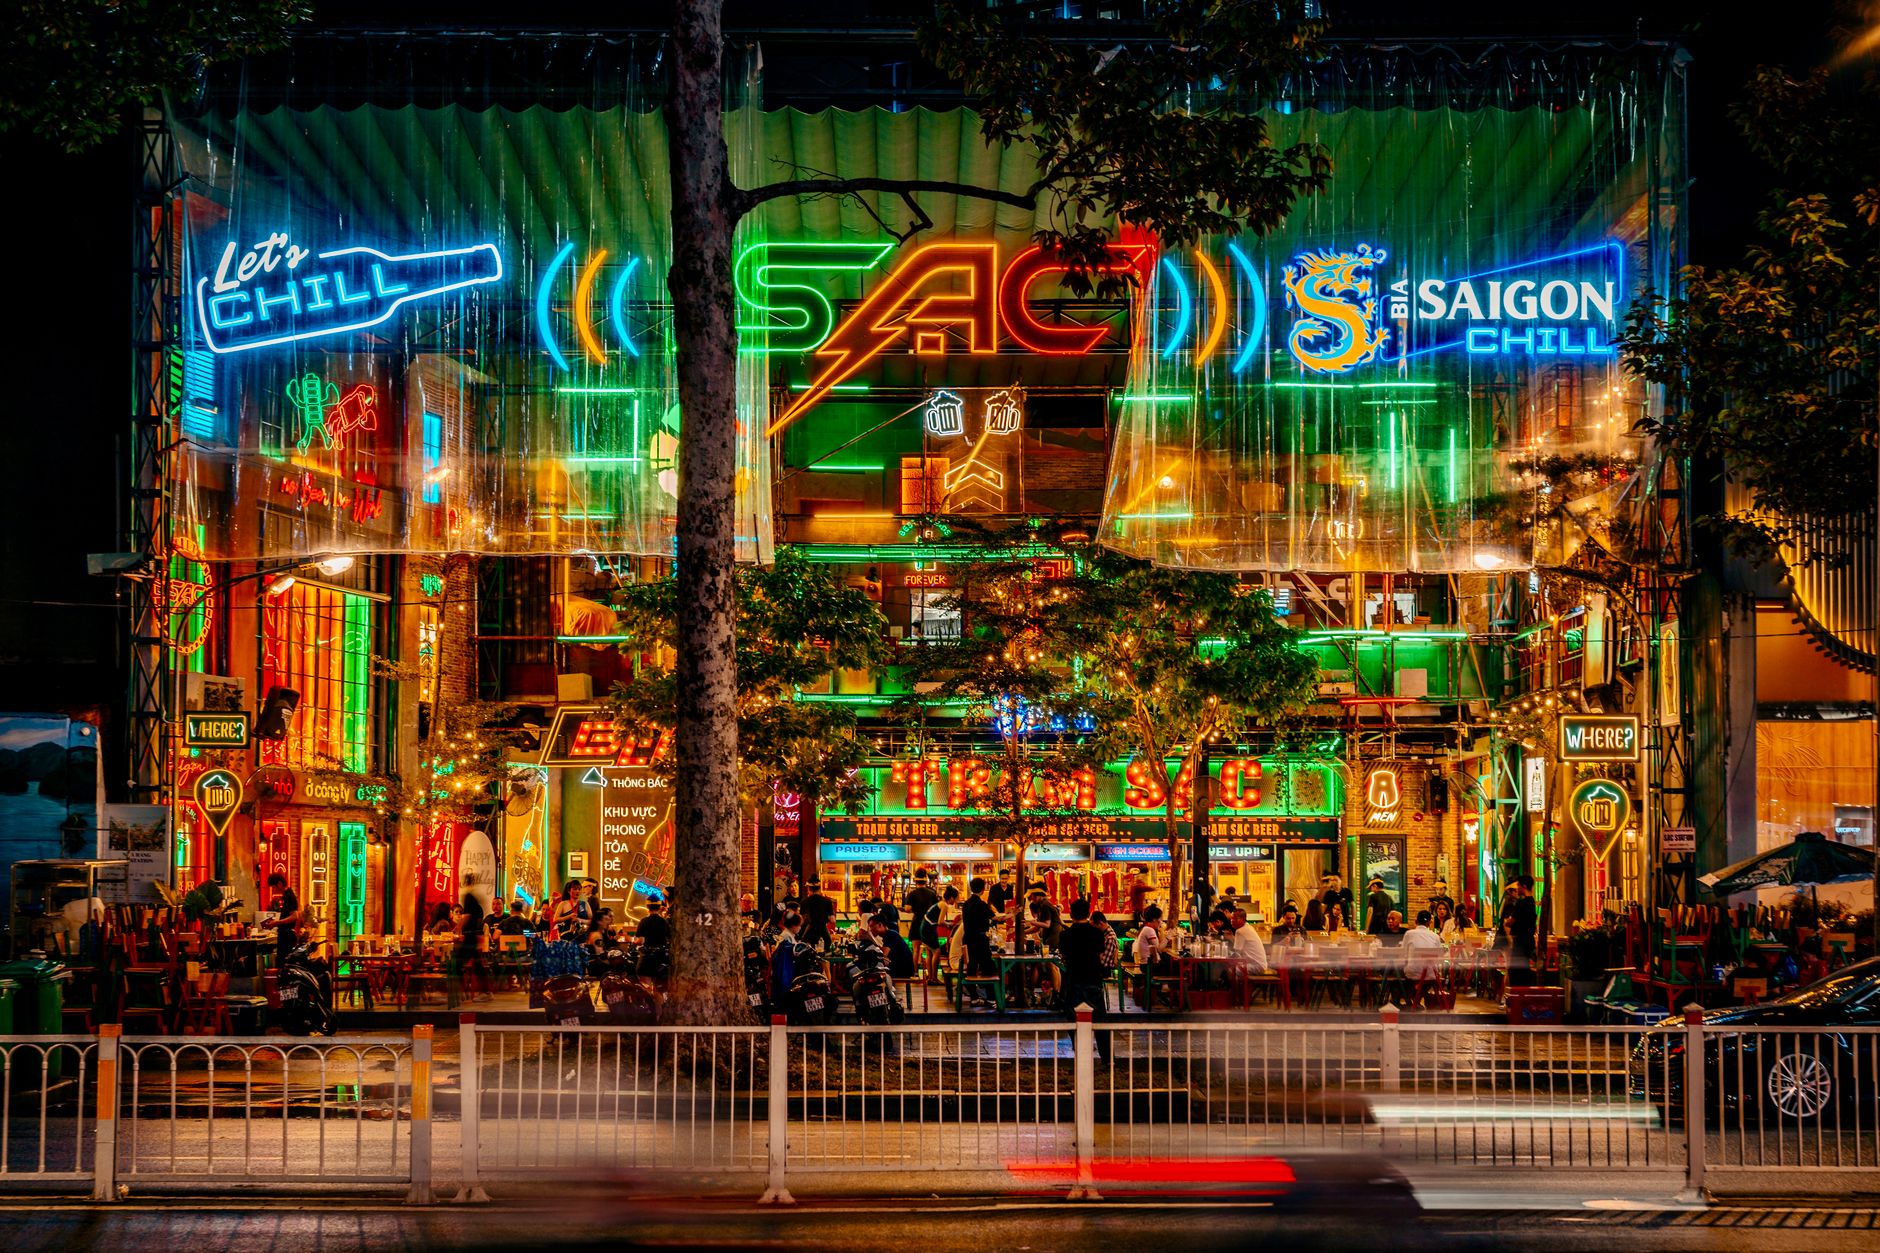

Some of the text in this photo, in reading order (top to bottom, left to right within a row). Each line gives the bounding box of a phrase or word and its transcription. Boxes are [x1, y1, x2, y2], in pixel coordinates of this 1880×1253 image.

[213, 233, 310, 292] Let's
[210, 263, 409, 329] CHILL
[1391, 279, 1409, 319] BIA
[1418, 279, 1615, 321] SAIGON
[1465, 327, 1614, 355] CHILL
[189, 721, 245, 739] WHERE?
[1566, 727, 1634, 749] WHERE?
[611, 776, 646, 788] THÔNG
[604, 806, 657, 820] KHU VỰC
[1370, 811, 1398, 823] MEN
[604, 824, 646, 836] PHONG
[912, 823, 938, 836] BEER
[1252, 823, 1280, 836] BEER
[604, 839, 629, 853] TỎA
[1235, 847, 1260, 857] UP!!
[464, 850, 491, 866] HAPPY
[603, 877, 629, 891] SẠC
[695, 912, 713, 926] 42
